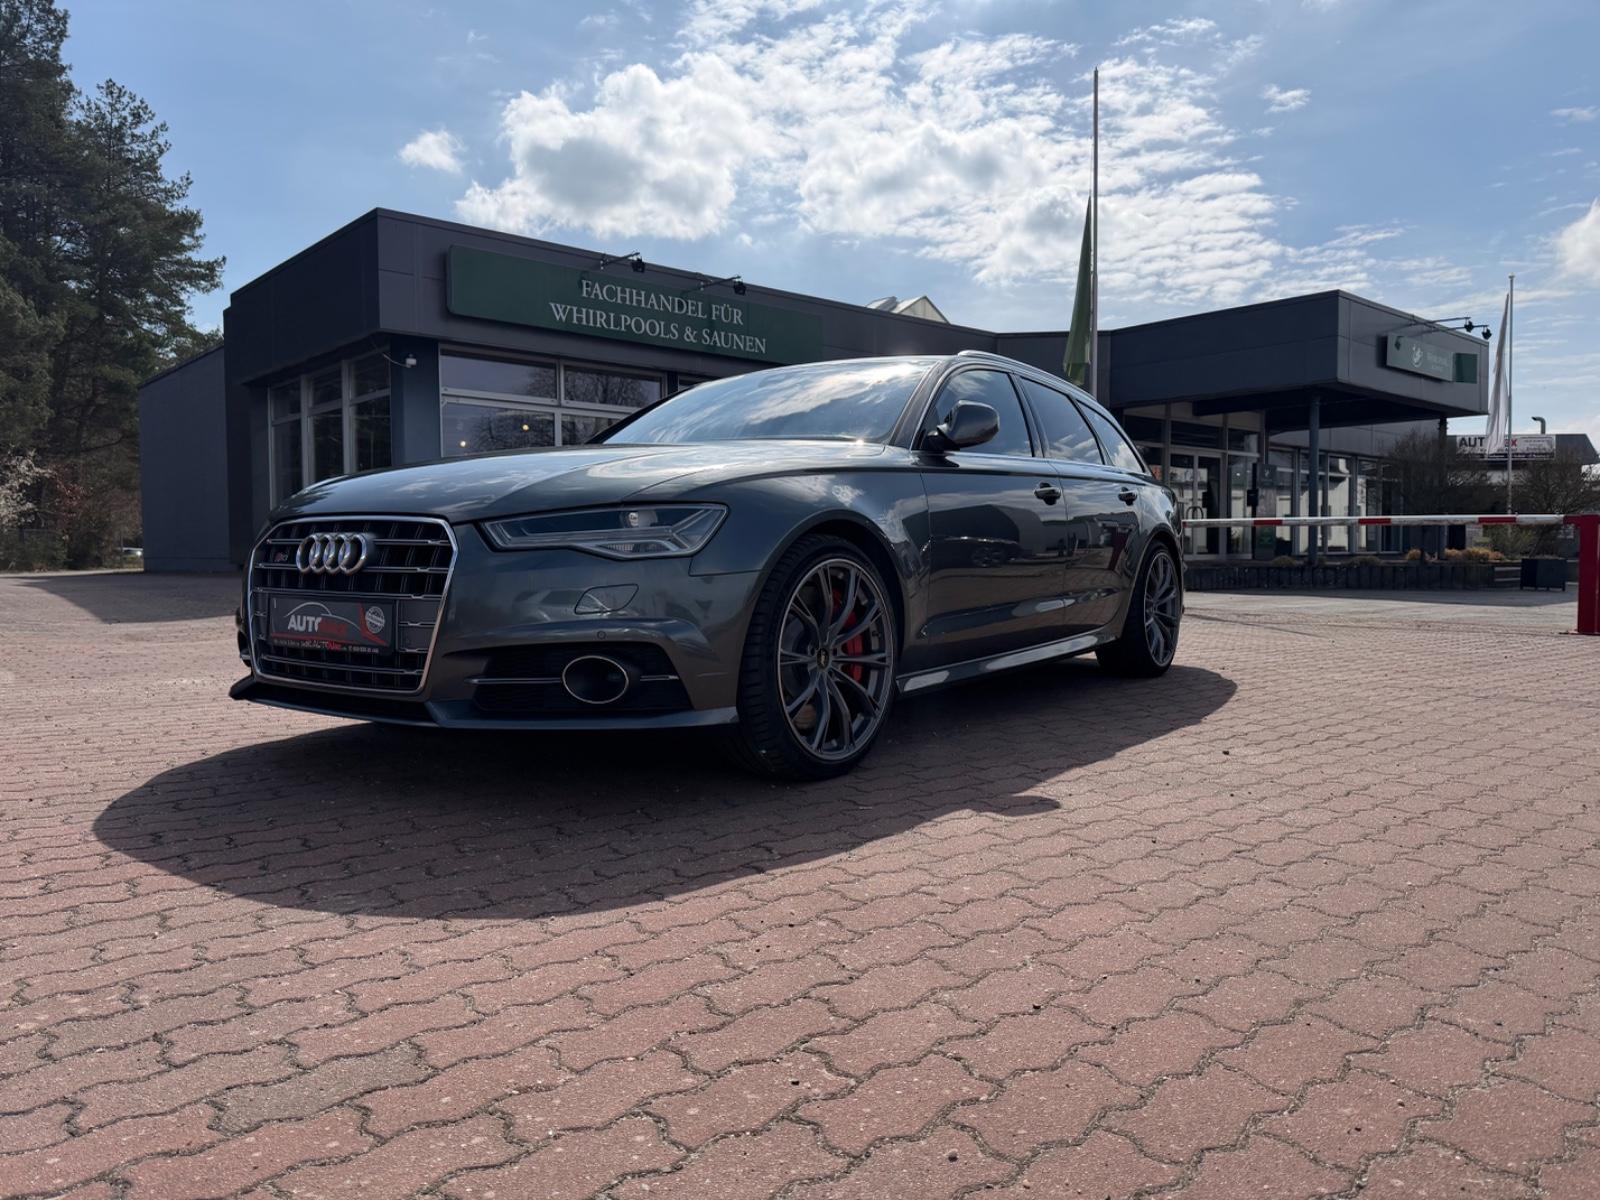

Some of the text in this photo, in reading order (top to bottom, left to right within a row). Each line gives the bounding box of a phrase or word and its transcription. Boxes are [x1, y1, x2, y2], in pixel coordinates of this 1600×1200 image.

[582, 280, 743, 325] FACHHANDEL FÜR
[550, 303, 766, 354] WHIRLPOOLS & SAUNEN
